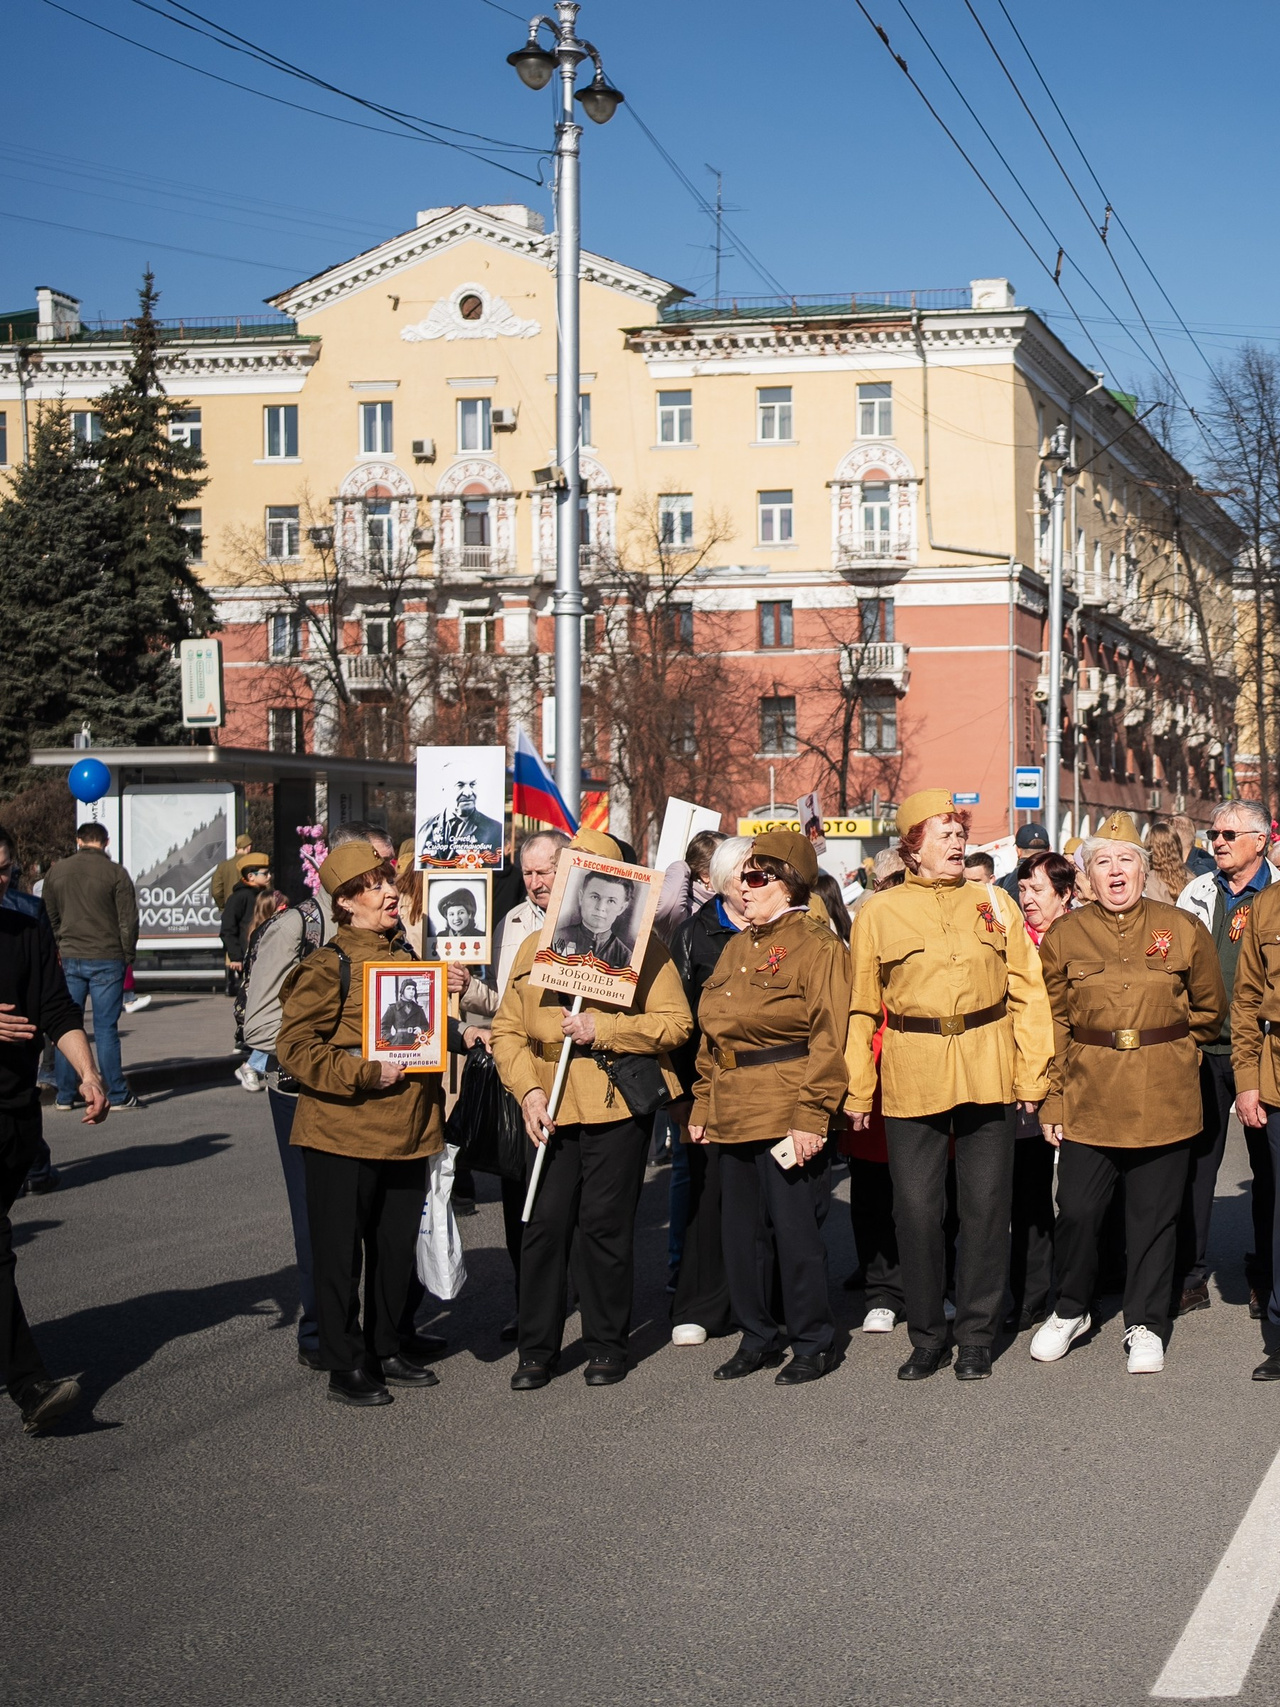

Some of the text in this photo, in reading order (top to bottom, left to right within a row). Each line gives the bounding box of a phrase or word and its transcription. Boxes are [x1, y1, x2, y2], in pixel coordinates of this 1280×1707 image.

[582, 859, 651, 883] БЕССМЕРТНЫЙ ПОЛК
[139, 887, 209, 907] 300 ЛЕТ
[541, 973, 626, 1000] Иван Павлович
[558, 966, 614, 987] ЗОБОЛЕВ
